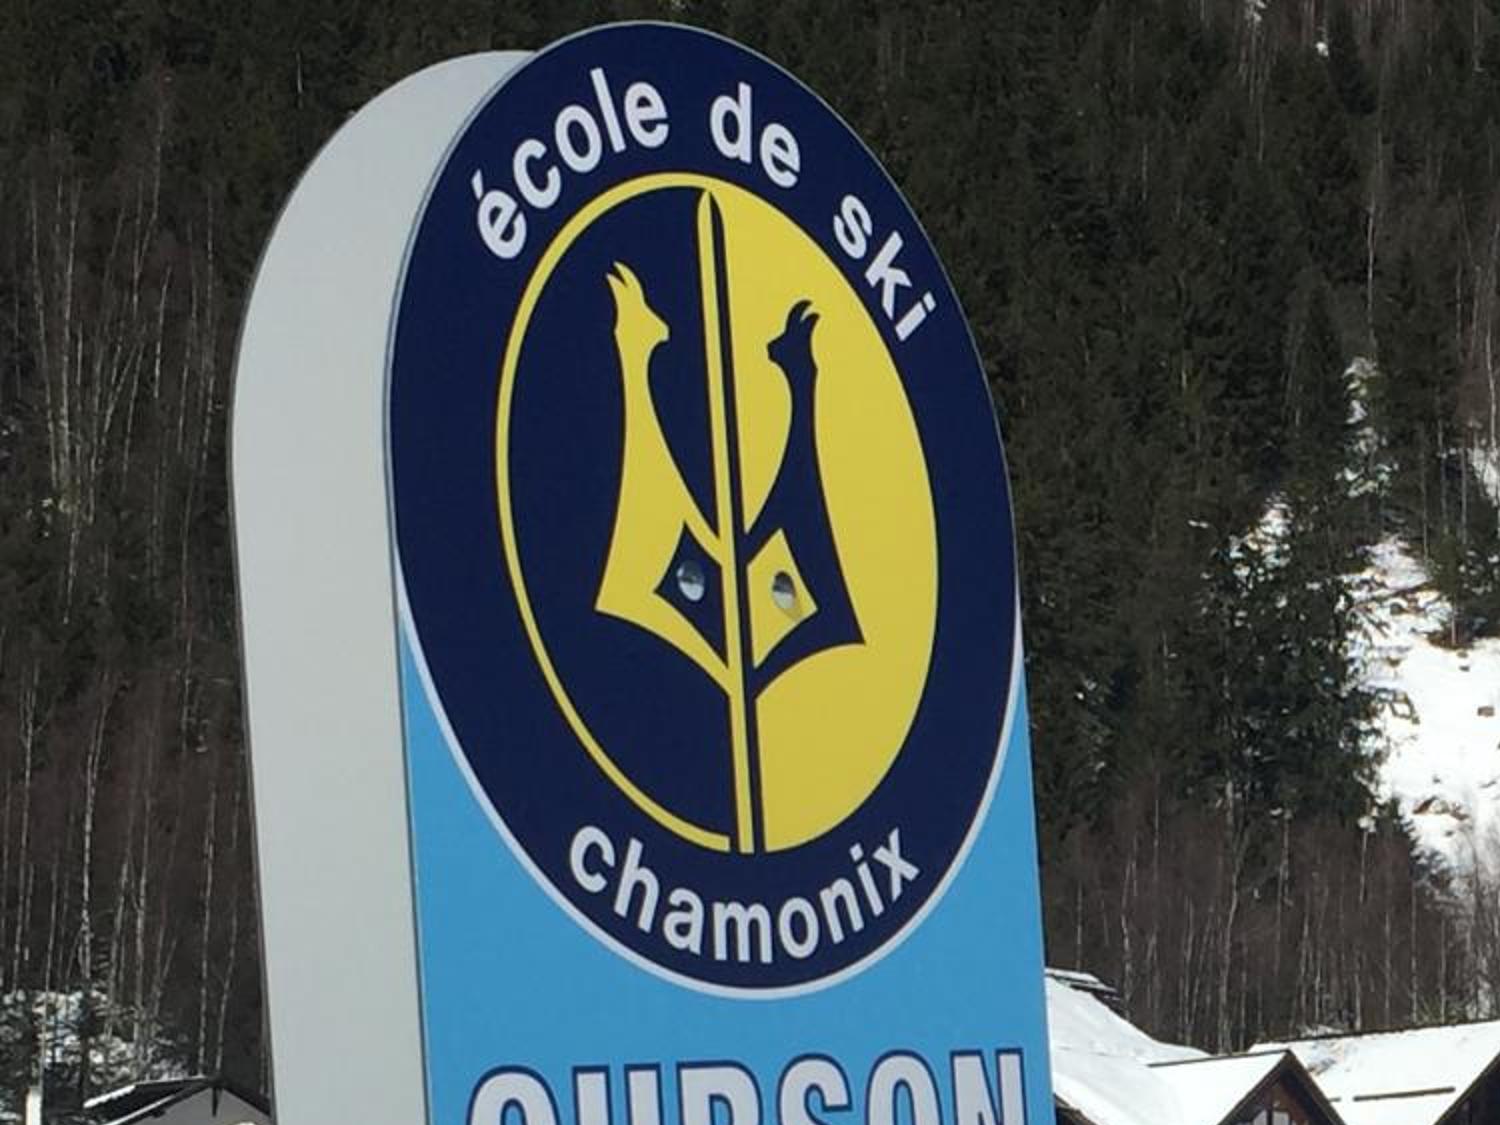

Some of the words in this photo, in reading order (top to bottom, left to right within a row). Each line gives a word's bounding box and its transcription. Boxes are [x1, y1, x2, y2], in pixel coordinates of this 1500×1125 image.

[473, 67, 669, 259] école
[709, 82, 800, 188] de
[833, 194, 936, 341] ski
[568, 825, 919, 963] chamonix
